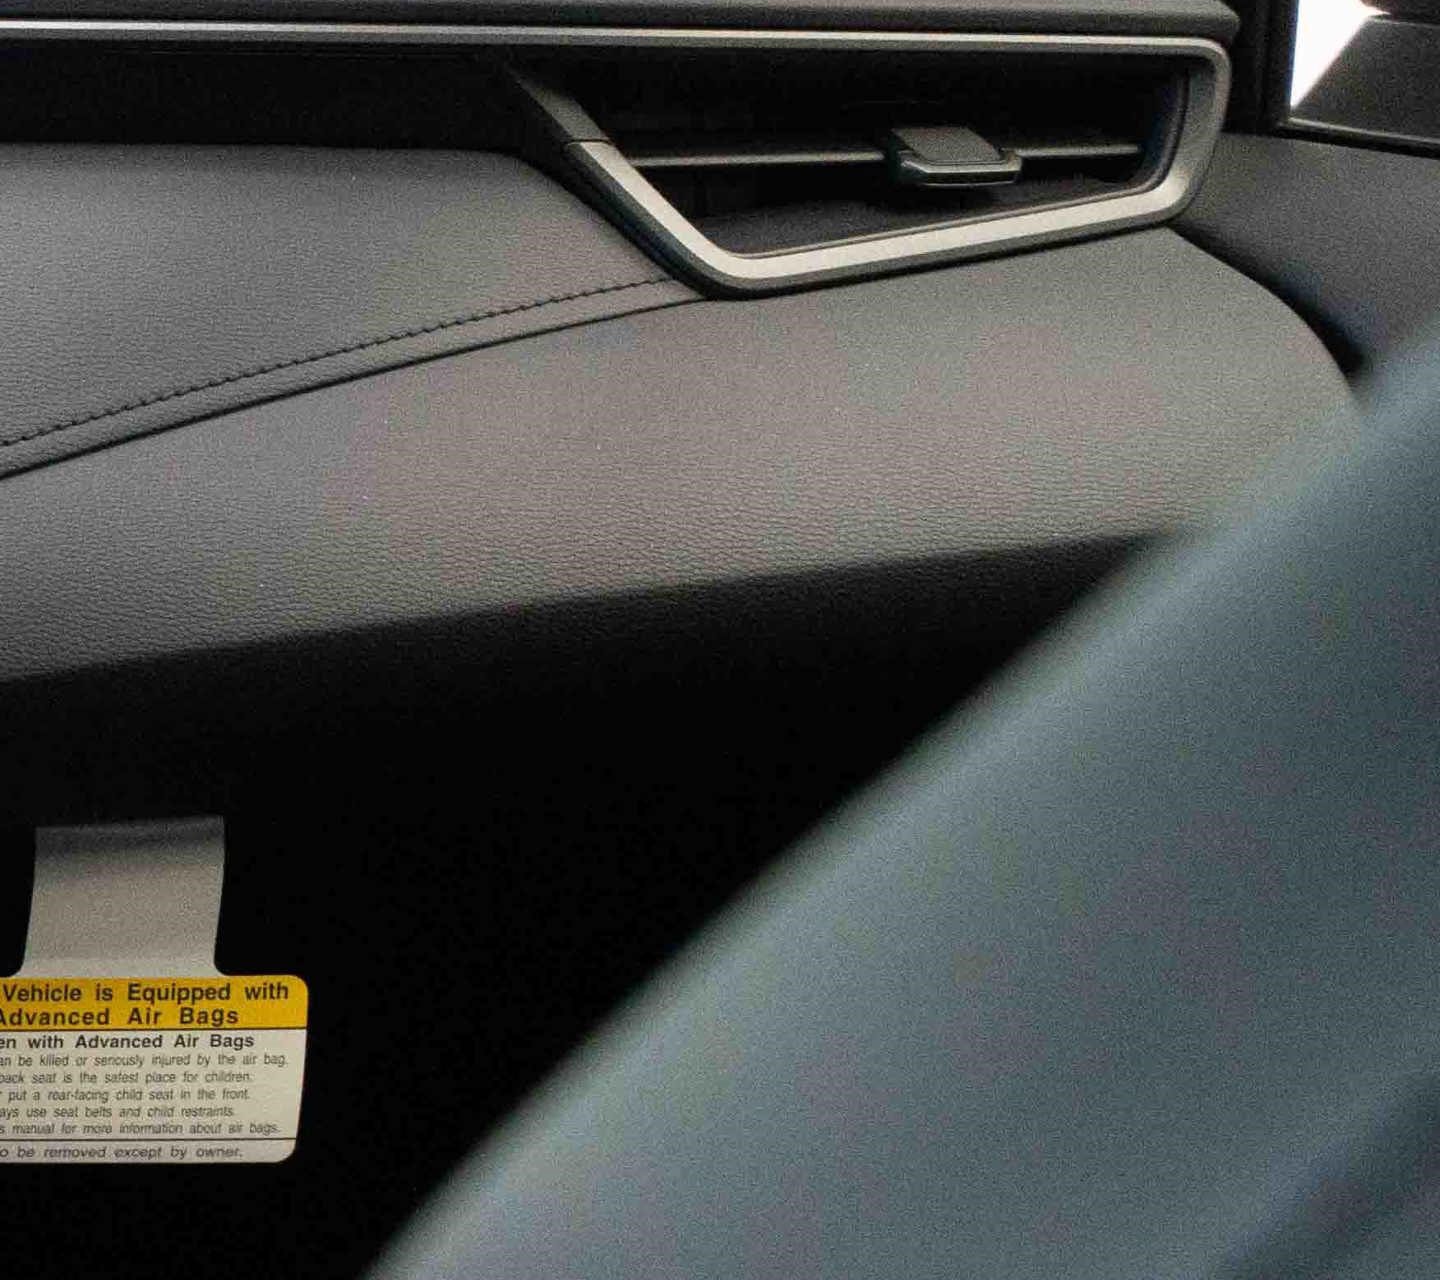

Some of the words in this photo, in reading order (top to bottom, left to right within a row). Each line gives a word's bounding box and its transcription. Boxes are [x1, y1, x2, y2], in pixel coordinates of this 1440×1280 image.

[3, 983, 82, 1003] Vehicle
[96, 983, 113, 1001] is
[128, 982, 231, 1005] Equipped
[245, 981, 289, 1001] with
[128, 1007, 162, 1025] Air
[180, 1007, 239, 1027] Bags
[28, 1034, 64, 1049] with
[75, 1033, 163, 1049] Advanced
[174, 1033, 200, 1048] Air
[210, 1033, 255, 1051] Bags
[18, 1055, 33, 1067] be
[39, 1054, 69, 1067] killed
[75, 1056, 88, 1066] or
[93, 1054, 145, 1068] seriously
[151, 1054, 191, 1068] injured
[197, 1054, 211, 1068] by
[218, 1054, 236, 1065] the
[242, 1054, 257, 1065] air
[264, 1053, 289, 1068] bag.
[31, 1072, 56, 1083] seat
[63, 1071, 73, 1083] is
[79, 1071, 98, 1083] the
[104, 1071, 139, 1084] safest
[145, 1071, 176, 1085] place
[183, 1070, 199, 1082] for
[204, 1071, 253, 1083] children.
[8, 1089, 27, 1103] put
[47, 1088, 109, 1103] rear-facing
[115, 1088, 143, 1100] child
[148, 1088, 174, 1100] seat
[180, 1088, 191, 1100] in
[197, 1088, 216, 1100] the
[222, 1088, 251, 1101] front.
[26, 1107, 47, 1118] use
[53, 1106, 78, 1118] seat
[85, 1106, 113, 1118] belts
[119, 1105, 142, 1117] and
[147, 1105, 174, 1117] child
[12, 1122, 56, 1135] manual
[61, 1121, 77, 1134] for
[83, 1124, 113, 1134] more
[119, 1121, 183, 1134] information
[189, 1121, 223, 1134] about
[228, 1122, 243, 1133] air
[249, 1121, 282, 1136] bags.
[17, 1145, 36, 1158] be
[43, 1145, 107, 1158] removed
[114, 1146, 163, 1161] except
[170, 1145, 188, 1160] by
[196, 1147, 242, 1158] owner.
